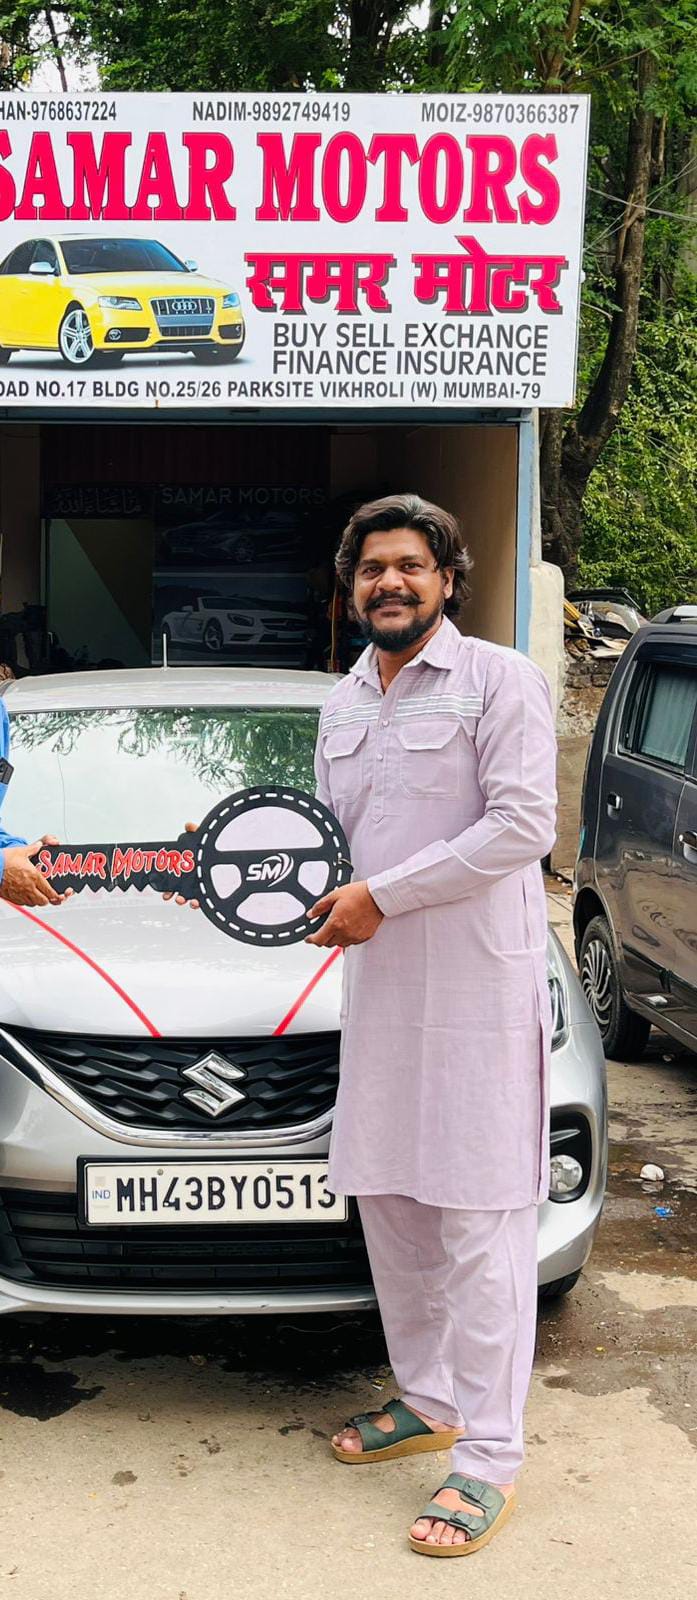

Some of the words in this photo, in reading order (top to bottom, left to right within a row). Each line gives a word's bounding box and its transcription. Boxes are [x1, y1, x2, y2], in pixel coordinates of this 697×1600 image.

[192, 101, 351, 122] NADIM-9892749419
[421, 102, 580, 124] MOIZ-9870366387
[255, 131, 560, 225] MOTORS
[243, 252, 397, 316] समर
[411, 235, 569, 317] मोटर
[273, 322, 327, 348] BUY
[336, 322, 395, 348] SELL
[404, 322, 549, 350] EXCHANGE
[272, 350, 387, 375] FINANCE
[396, 350, 547, 377] INSURANCE
[36, 380, 87, 397] NO.17
[92, 380, 139, 398] BLDG
[145, 380, 222, 398] NO.25/26
[227, 380, 314, 398] PARKSITE
[319, 381, 404, 398] VIKHROLI
[410, 381, 437, 402] (W)
[443, 381, 541, 400] MUMBAI-79
[161, 487, 233, 505] SAMAR
[238, 487, 326, 505] MOTORS
[36, 850, 107, 880] SAMAR
[111, 847, 194, 882] MOTORS
[246, 863, 282, 883] SM
[91, 1189, 111, 1200] IND
